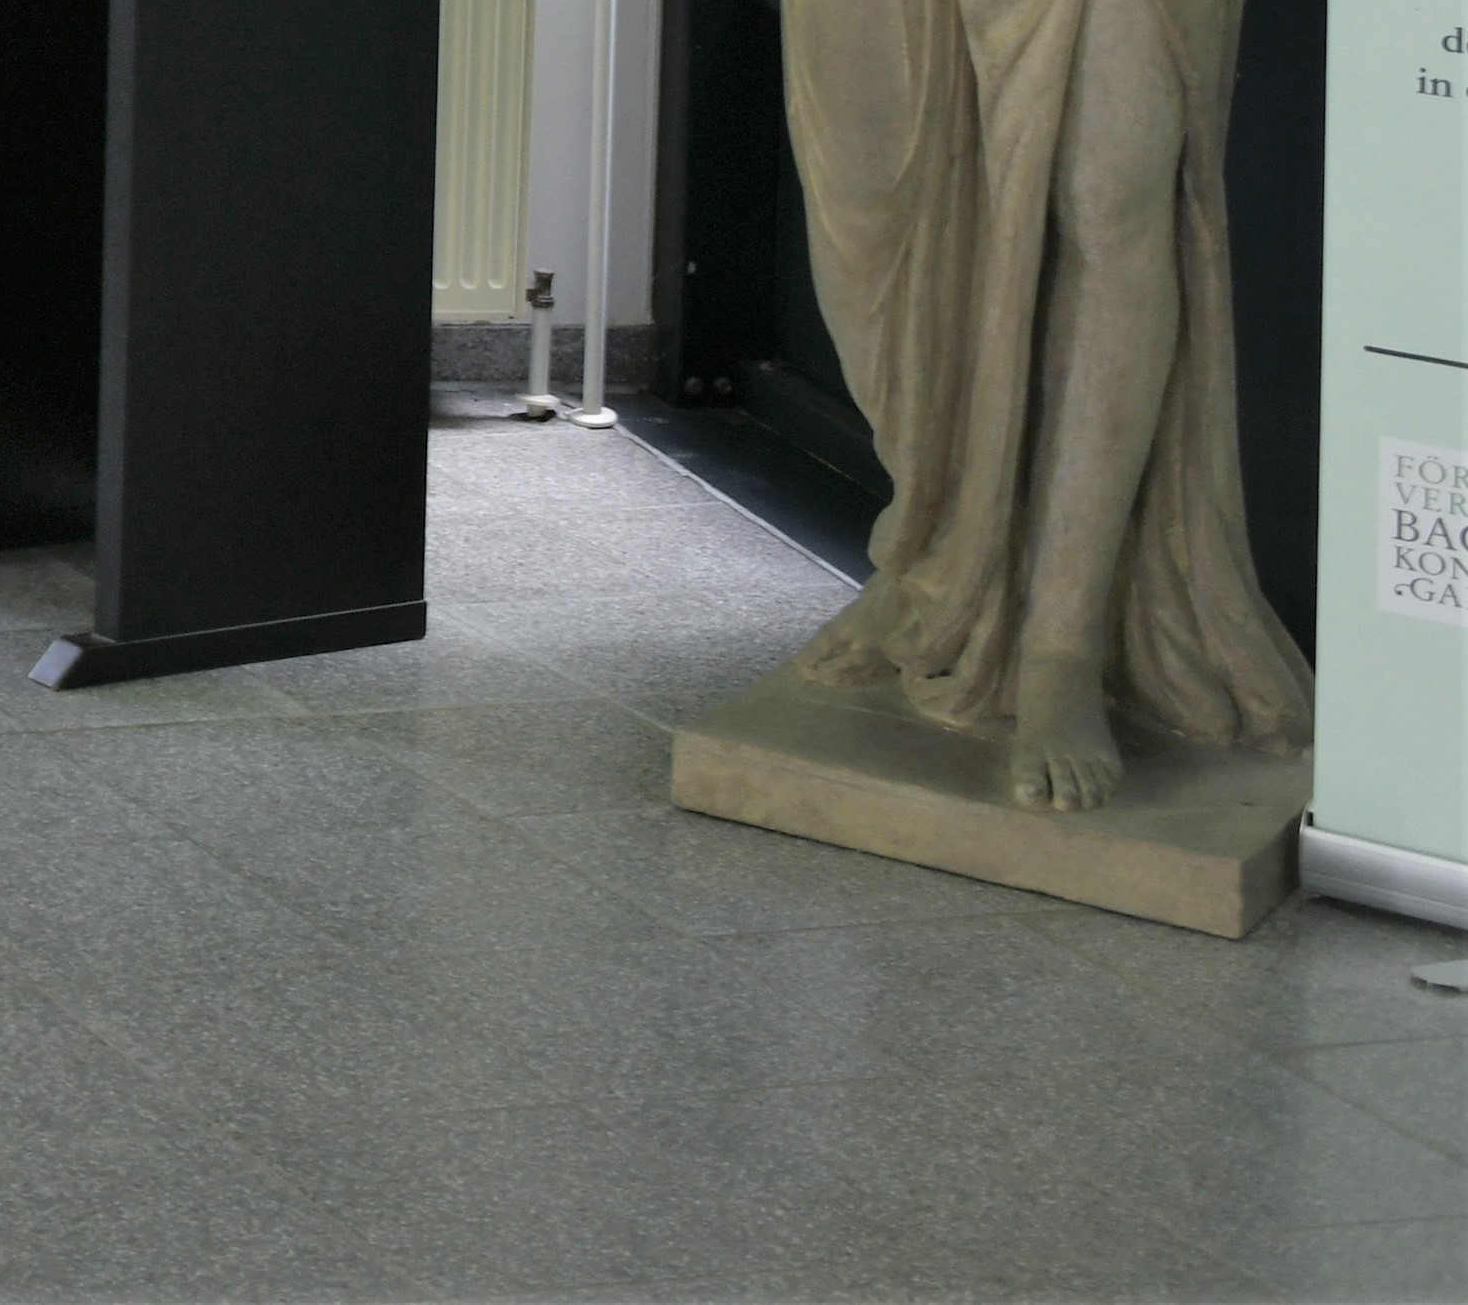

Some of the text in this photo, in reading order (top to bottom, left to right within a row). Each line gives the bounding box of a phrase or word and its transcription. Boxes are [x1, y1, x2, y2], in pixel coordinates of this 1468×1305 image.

[1441, 26, 1468, 54] d
[1416, 67, 1454, 98] in
[1394, 453, 1468, 490] FÖR
[1394, 481, 1468, 518] VER
[1394, 545, 1468, 580] KON
[1394, 577, 1468, 609] GA
